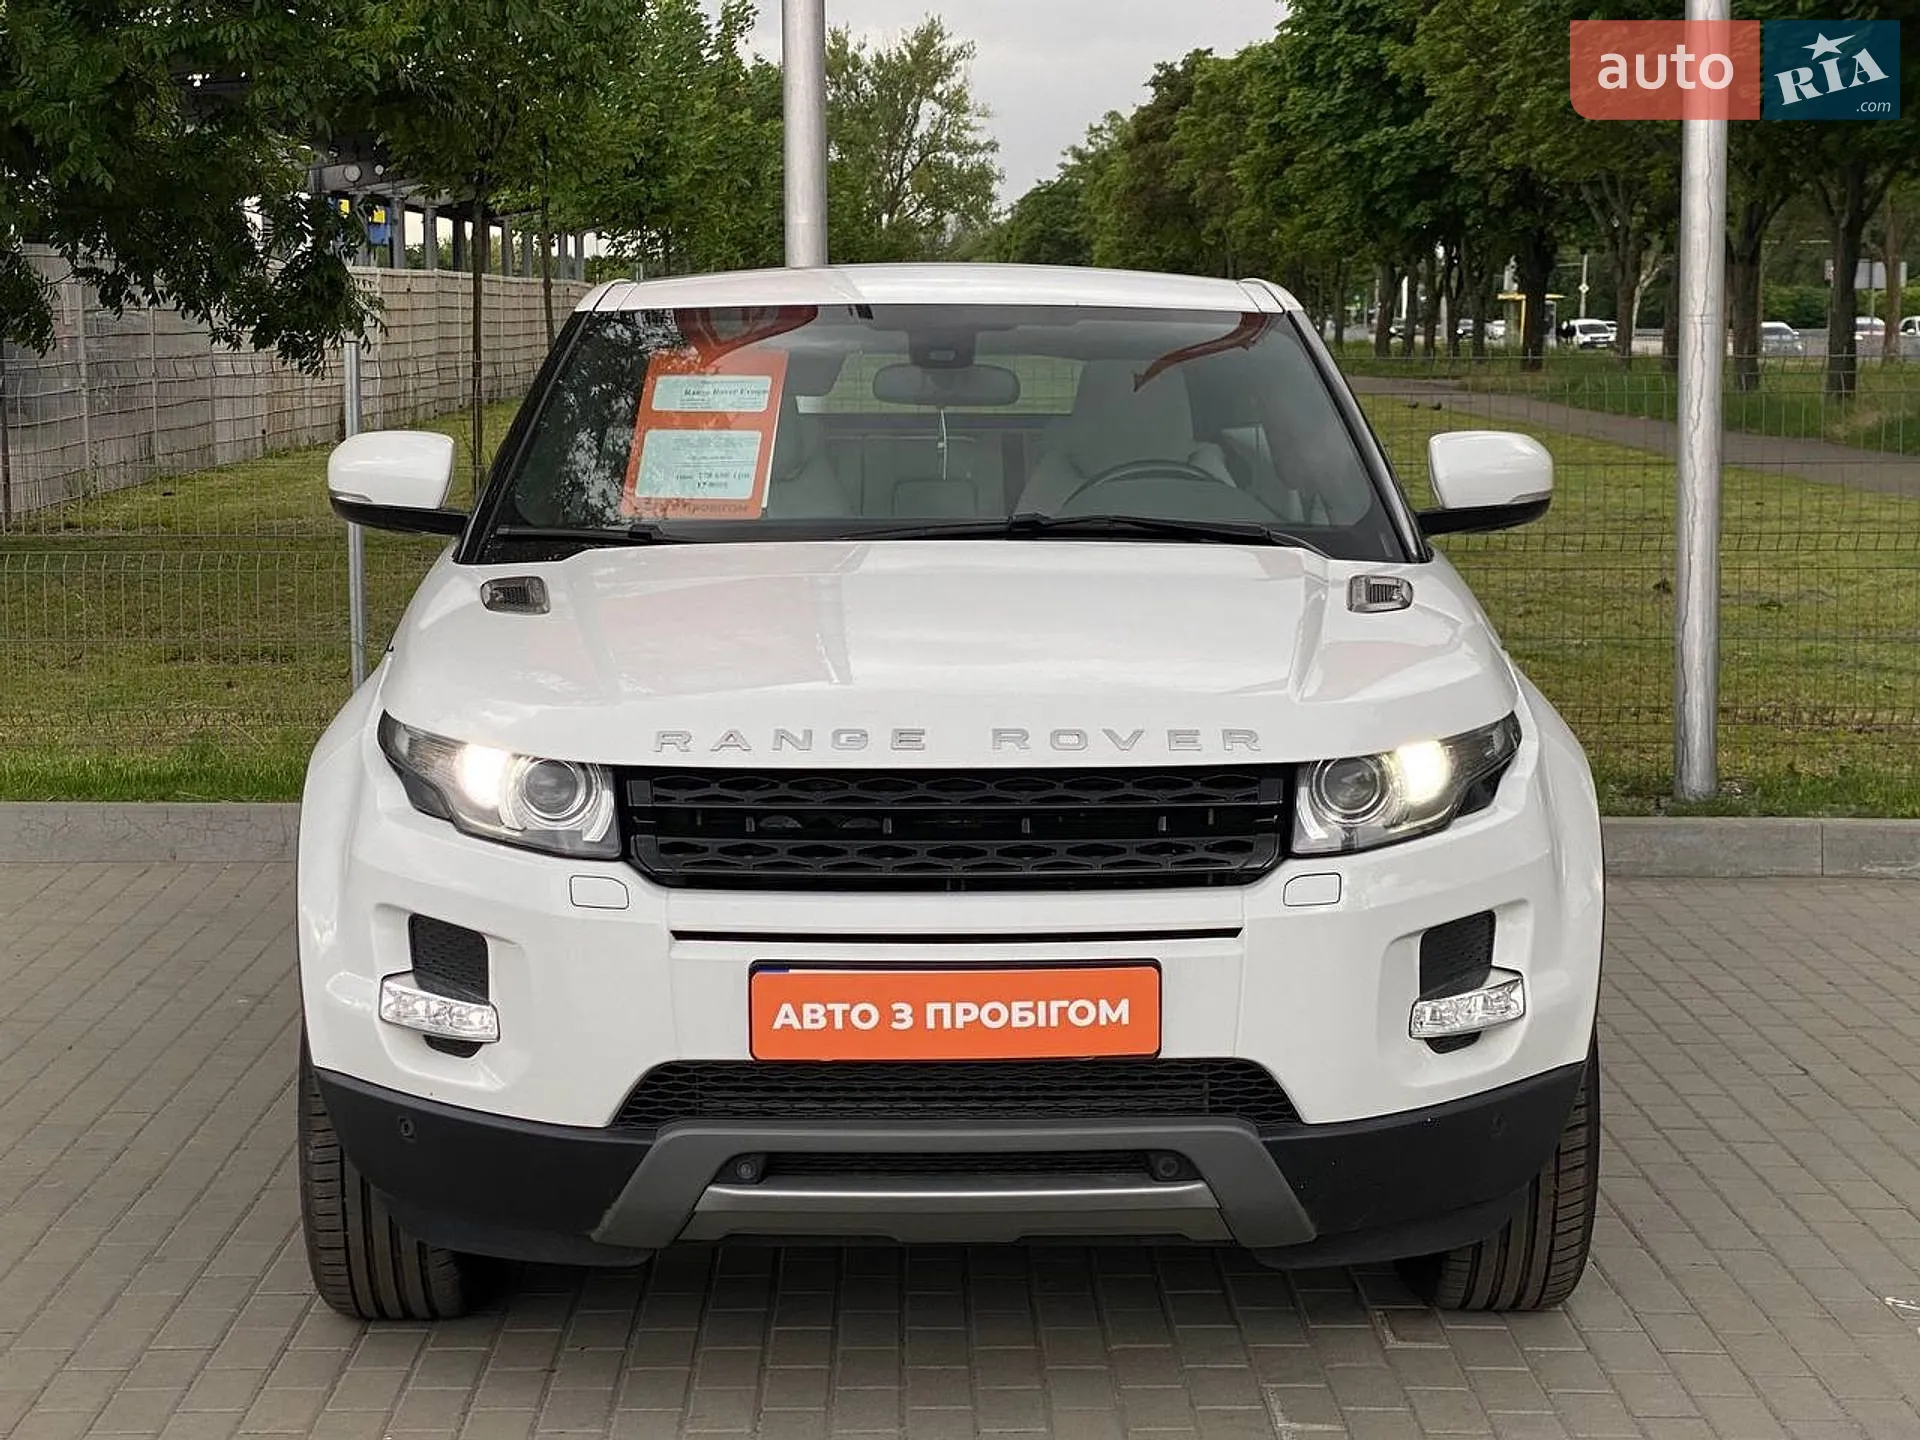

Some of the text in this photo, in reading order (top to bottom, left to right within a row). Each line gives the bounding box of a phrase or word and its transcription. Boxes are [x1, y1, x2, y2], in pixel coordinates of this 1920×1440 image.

[653, 728, 1263, 753] RANGE ROVER
[772, 1002, 880, 1030] АВТО
[925, 998, 1130, 1030] ПРОБІГОМ
